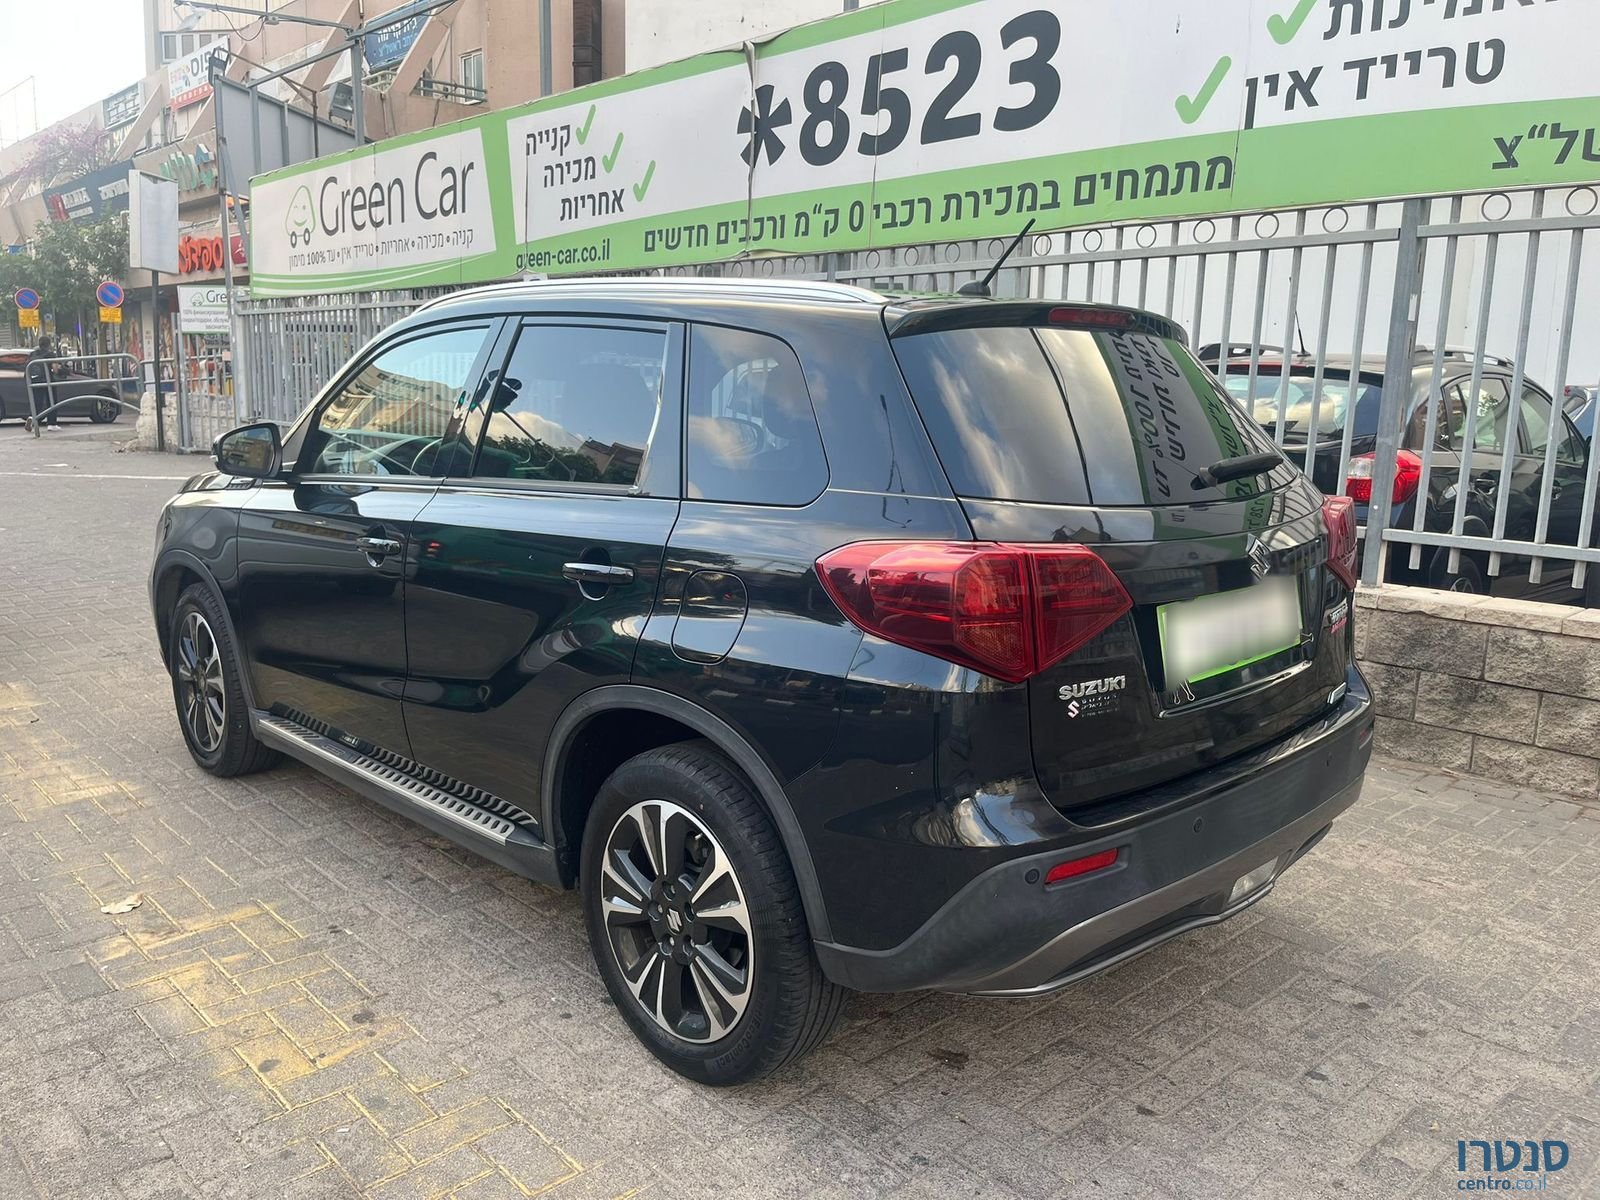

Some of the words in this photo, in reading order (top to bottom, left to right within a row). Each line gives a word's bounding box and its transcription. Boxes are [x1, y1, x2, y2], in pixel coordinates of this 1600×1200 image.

[1344, 38, 1505, 100] טרייד
[1244, 65, 1324, 129] אין
[526, 124, 571, 156] קנייה
[544, 157, 596, 188] מכירה
[1074, 156, 1232, 206] מתמחים
[320, 176, 405, 237] Green
[415, 151, 474, 219] Car
[560, 188, 625, 222] אחריות
[942, 179, 1060, 224] במכירת
[716, 214, 786, 243] ורכבים
[794, 204, 838, 237] ק"מ
[848, 201, 864, 232] 0
[873, 198, 931, 230] רכבי
[353, 244, 373, 257] טרייד
[381, 240, 410, 255] אחריות
[418, 232, 443, 250] מכירה
[452, 229, 473, 248] קניה
[643, 223, 709, 255] חדשים
[289, 255, 305, 271] מימון
[307, 252, 325, 264] 100%
[326, 250, 335, 262] עד
[341, 250, 351, 264] אין
[1059, 675, 1126, 700] SUZUKI
